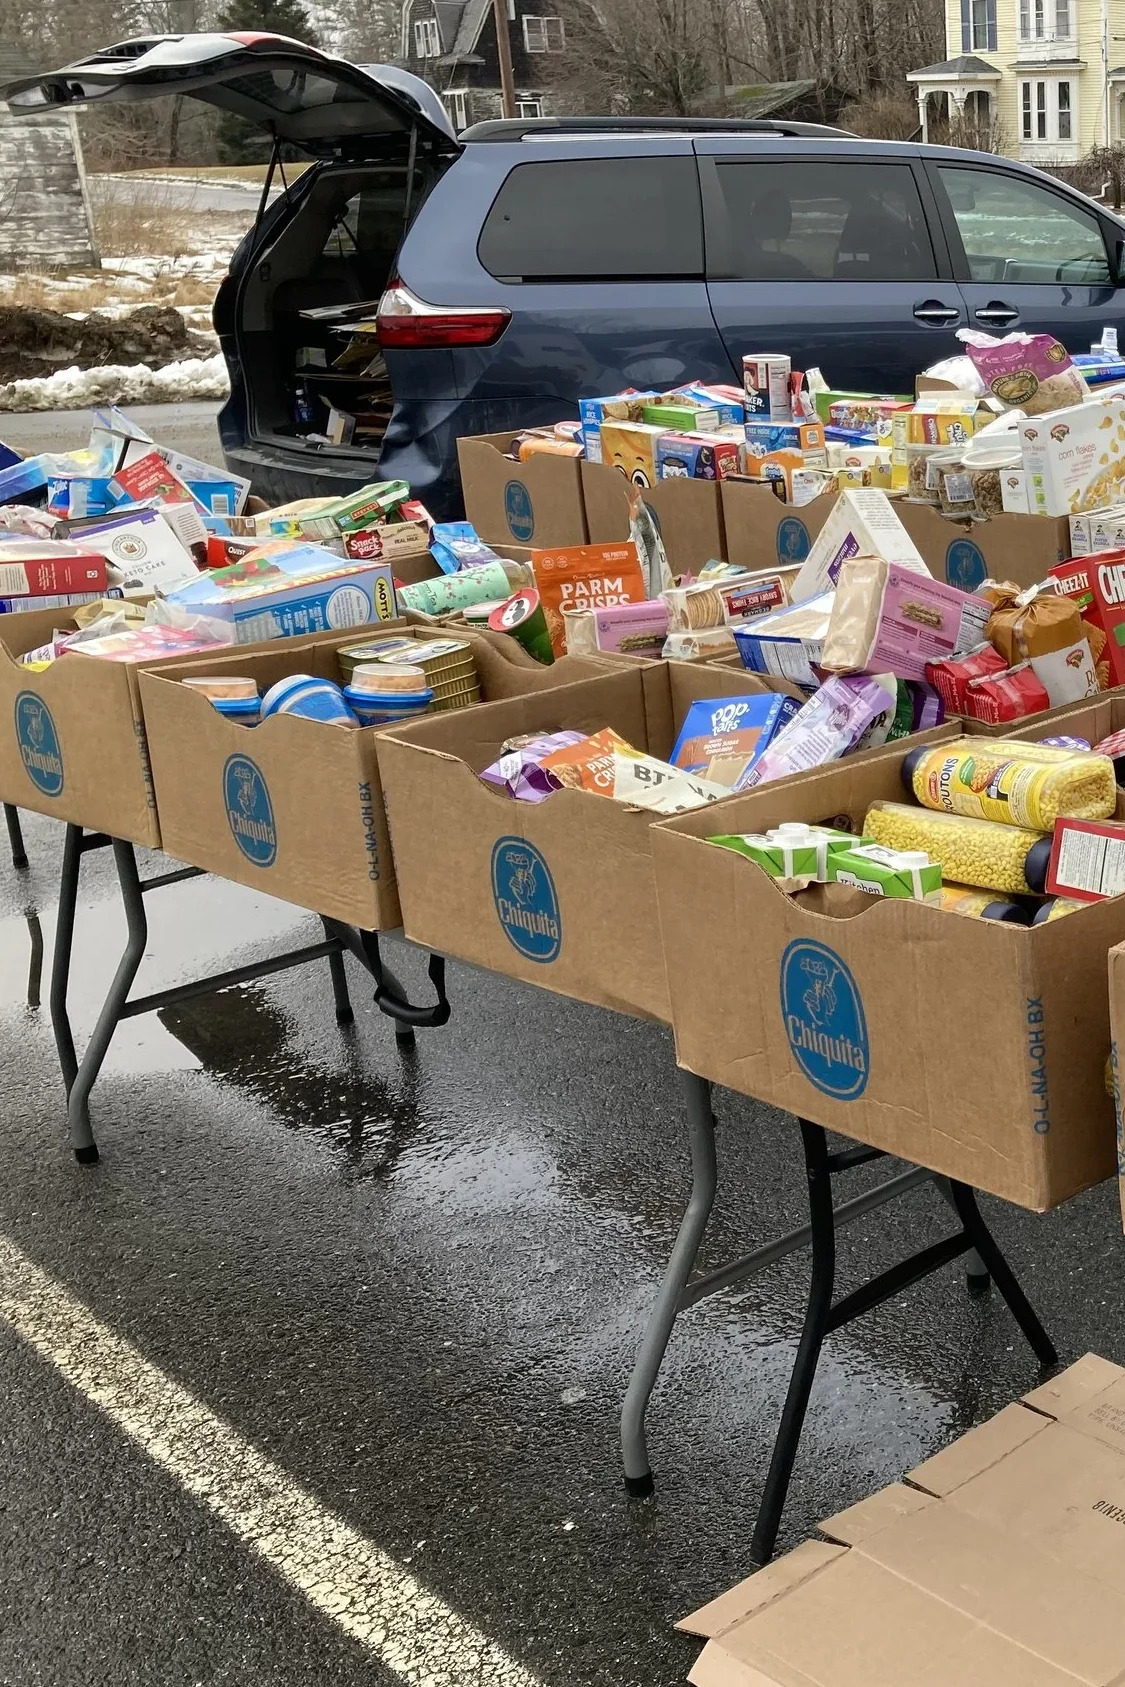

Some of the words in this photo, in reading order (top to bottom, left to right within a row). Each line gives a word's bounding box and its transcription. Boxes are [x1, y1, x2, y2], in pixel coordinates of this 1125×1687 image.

[1059, 450, 1075, 461] corn
[1076, 443, 1097, 457] flakes
[350, 538, 379, 551] Snack
[358, 542, 381, 555] pack
[560, 577, 623, 599] PARM
[558, 594, 630, 614] CRISPS
[20, 745, 63, 776] Chiquita
[593, 766, 615, 788] CRI
[941, 758, 960, 812] ROUTONS
[360, 782, 372, 803] BX
[228, 811, 276, 847] Chiquita
[498, 898, 561, 942] Chiquita
[1027, 994, 1044, 1024] BX
[787, 1013, 866, 1073] Chiquita
[1029, 1029, 1051, 1135] O-L-NA-OH
